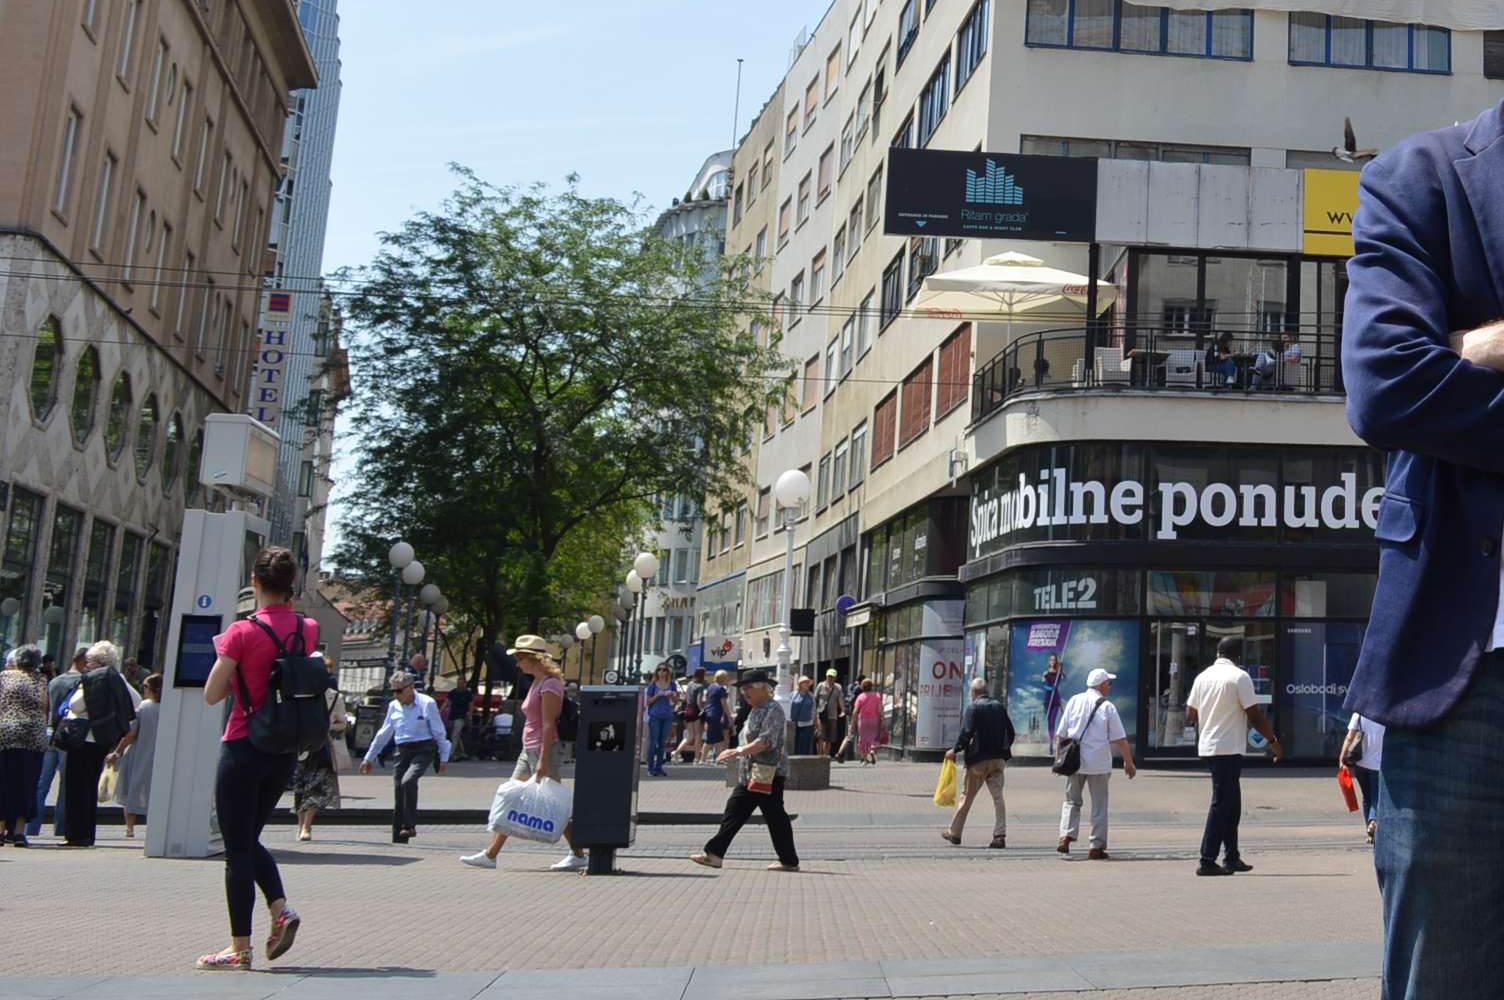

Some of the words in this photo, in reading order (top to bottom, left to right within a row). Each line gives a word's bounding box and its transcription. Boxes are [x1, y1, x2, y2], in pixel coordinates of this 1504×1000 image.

[961, 209, 992, 221] Ritam
[995, 212, 1026, 223] grada
[257, 330, 287, 422] HOTEL
[970, 482, 998, 558] Špica
[999, 467, 1143, 536] mobilne
[1034, 577, 1097, 609] TELE2
[711, 646, 727, 659] vip
[1286, 683, 1336, 695] Oslobodi
[507, 810, 554, 832] nama
